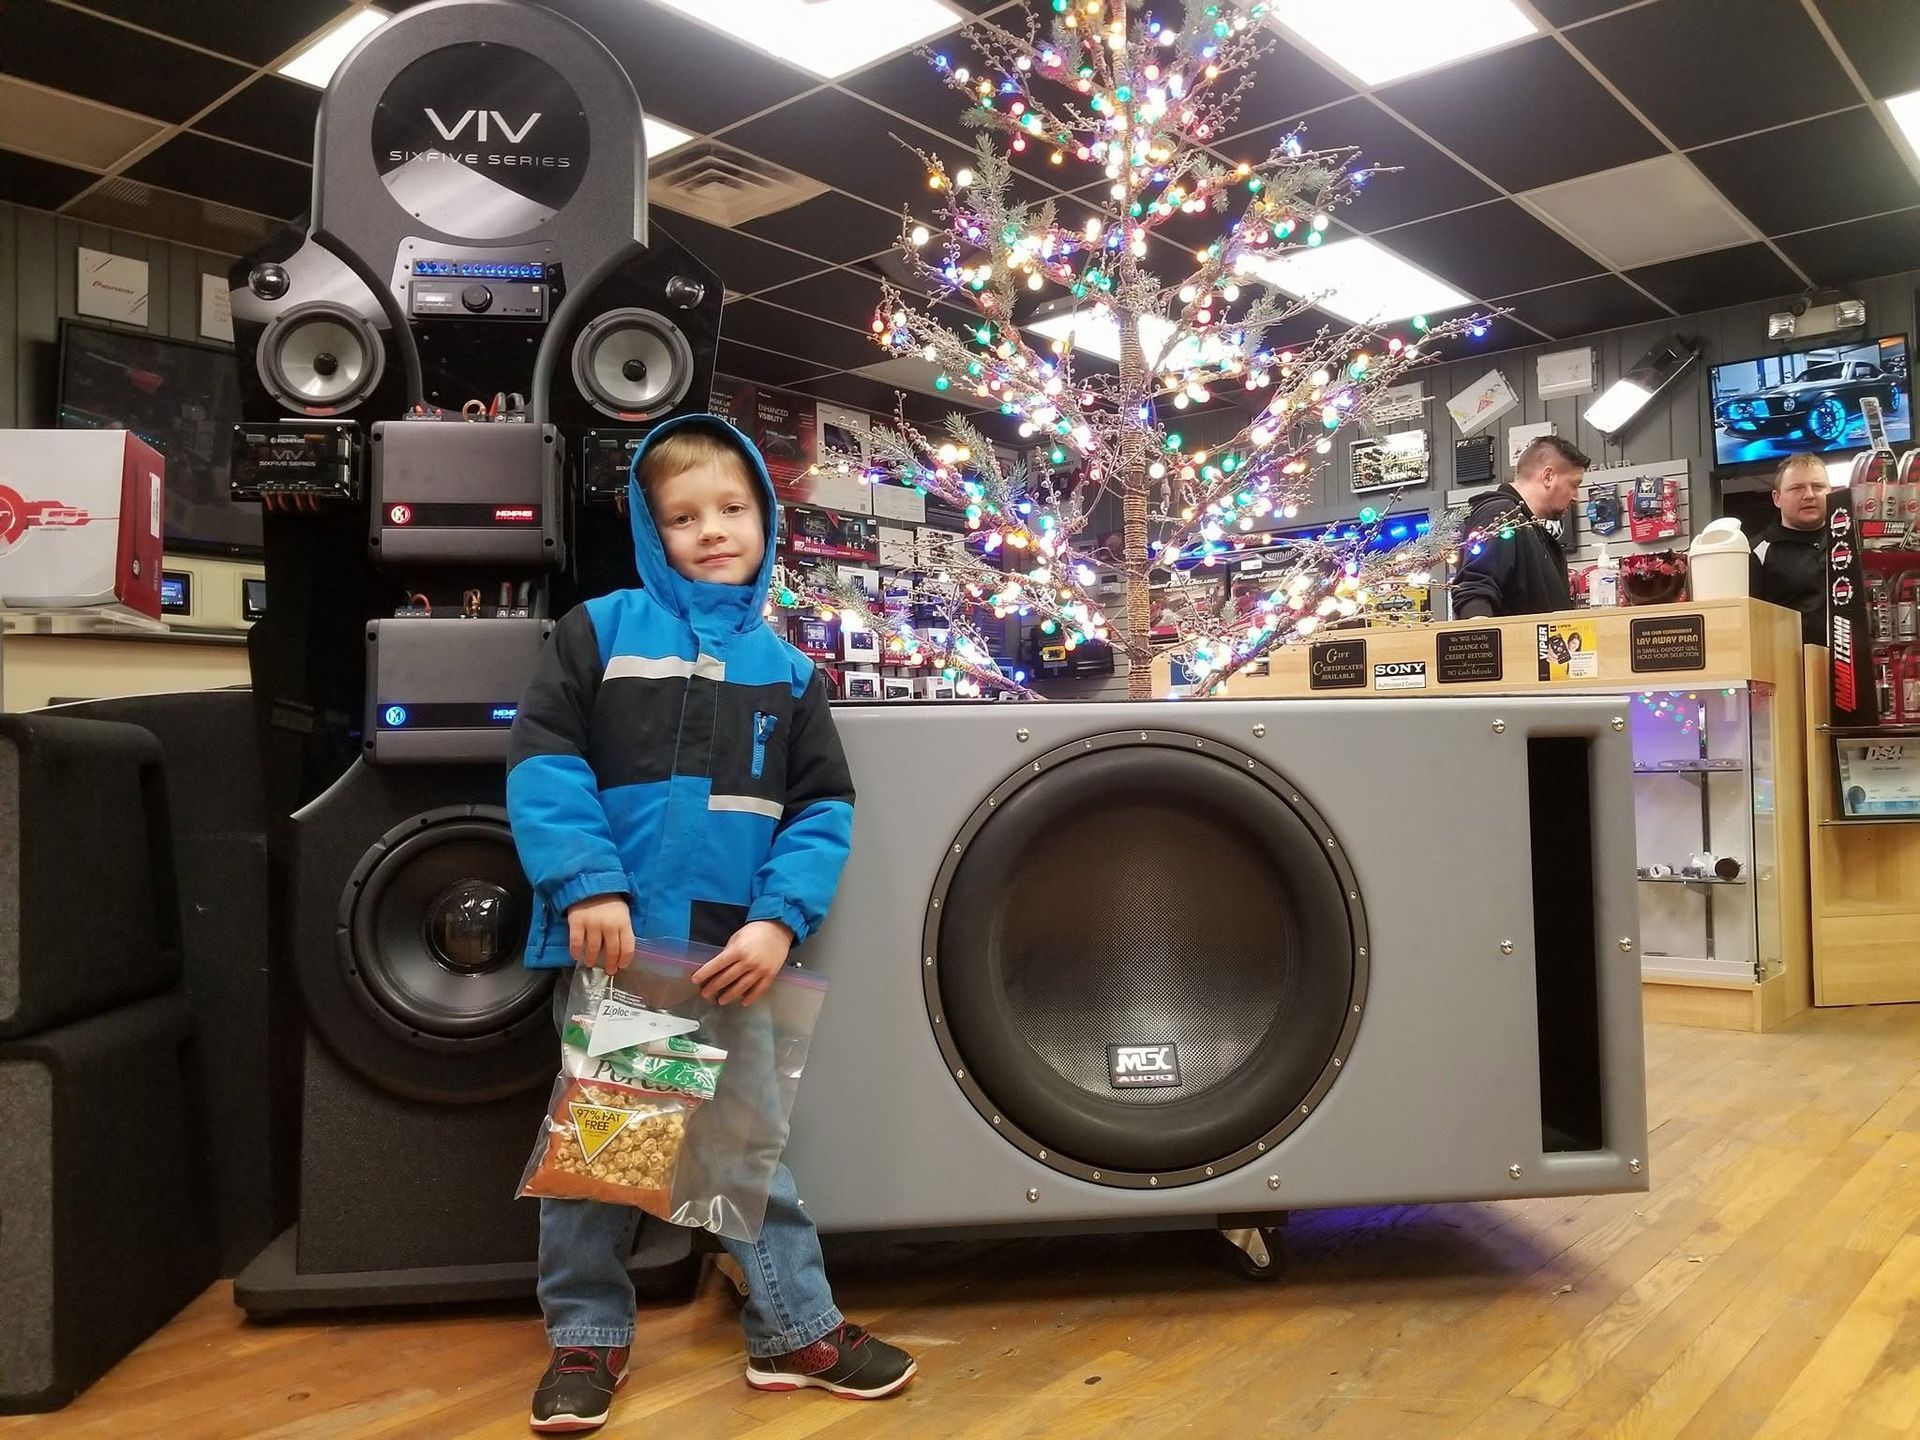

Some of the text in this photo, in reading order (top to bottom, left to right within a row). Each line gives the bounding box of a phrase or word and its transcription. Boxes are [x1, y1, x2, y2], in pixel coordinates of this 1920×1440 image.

[424, 108, 542, 143] VIV
[389, 150, 570, 168] SIXFIVE SERIES
[758, 404, 789, 417] ENHANCED
[730, 417, 737, 425] IT
[758, 412, 784, 423] VISIBILITY
[805, 536, 826, 546] NEX
[846, 541, 866, 550] NEX
[1538, 626, 1549, 660] VIPER
[1652, 635, 1677, 645] AWAY
[1679, 634, 1699, 643] PLAN
[807, 641, 828, 650] NEX
[1313, 661, 1364, 676] CERTIFICATES
[1375, 662, 1425, 676] SONY
[1321, 672, 1356, 681] AVAILABLE
[493, 709, 517, 717] MEMP
[1116, 1047, 1172, 1073] MTX
[1117, 1074, 1173, 1082] AUDIO
[577, 1109, 621, 1122] 97% FAT
[584, 1120, 610, 1131] FREE
